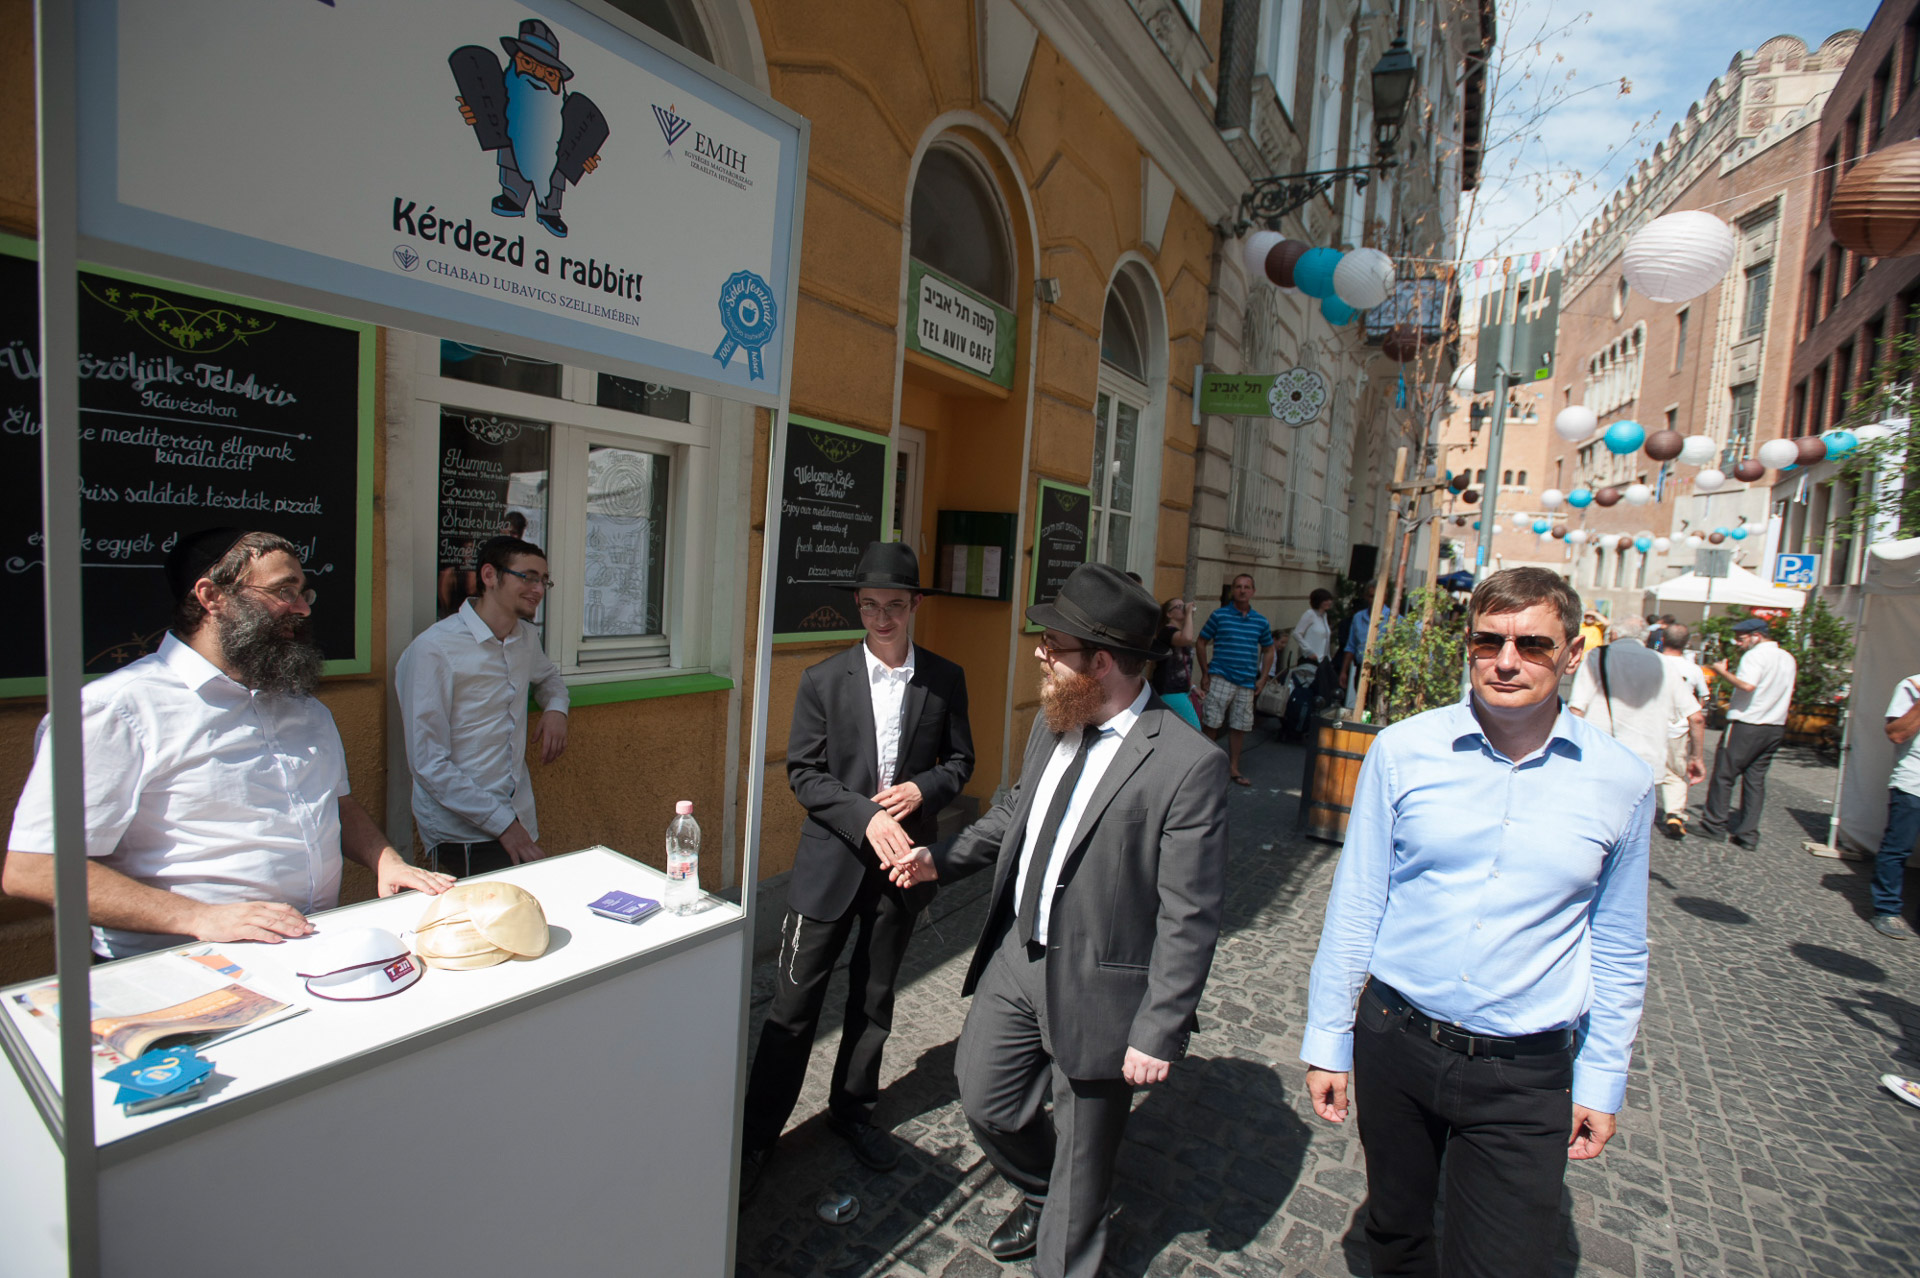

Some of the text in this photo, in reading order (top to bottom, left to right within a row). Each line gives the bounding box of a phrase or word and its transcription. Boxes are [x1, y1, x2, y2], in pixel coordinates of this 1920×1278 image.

[694, 131, 748, 174] EMIH
[690, 161, 718, 179] IZRAELITA
[393, 197, 643, 302] Kérdezd a rabbit!
[426, 259, 641, 326] CHABAD LUBAVICS SZELLEMÉBEN
[725, 279, 746, 308] Sólet
[924, 286, 994, 337] קפה תל אביב
[719, 337, 735, 361] 100%
[923, 318, 992, 364] TEL AVIV CAFE
[0, 340, 184, 391] Üözöljük
[183, 372, 195, 381] a
[1209, 380, 1262, 394] תל אביב
[141, 390, 238, 418] Kávézóban
[101, 426, 214, 452] mediterrán
[221, 436, 296, 462] étlapunk
[155, 448, 253, 471] kínálatát!
[444, 448, 503, 473] Hummus
[793, 465, 834, 485] Welcome
[442, 478, 497, 500] Couscous
[274, 495, 323, 515] pizzák
[781, 498, 800, 517] Enjoy
[800, 506, 811, 515] our
[442, 508, 512, 531] Shakshuka
[841, 524, 848, 539] of
[96, 533, 156, 560] egyéb
[440, 538, 478, 558] Israeli
[795, 536, 813, 560] fresh
[807, 564, 830, 577] pizzas
[1778, 556, 1802, 580] P
